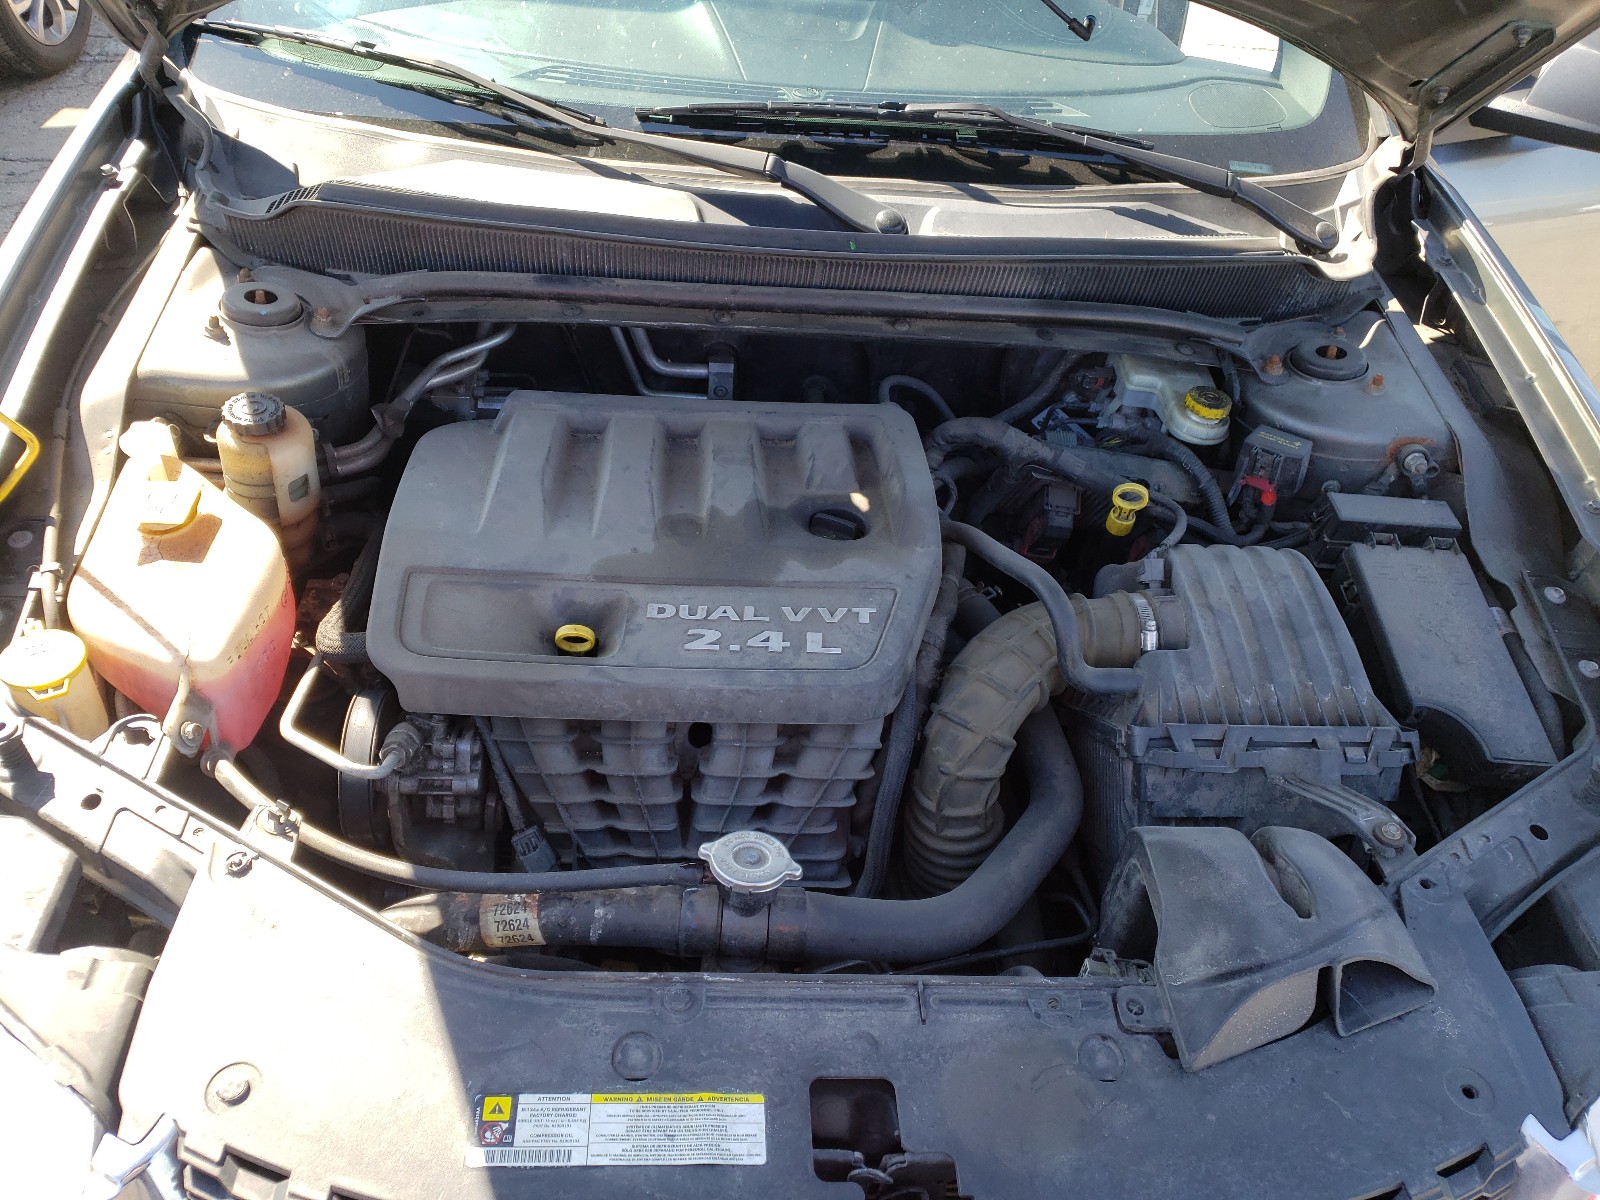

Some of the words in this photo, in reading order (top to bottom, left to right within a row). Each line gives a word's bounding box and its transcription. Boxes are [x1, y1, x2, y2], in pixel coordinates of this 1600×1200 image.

[646, 603, 770, 622] DUAL
[781, 606, 877, 624] VVT
[684, 628, 791, 653] 2.4
[806, 631, 842, 654] L
[493, 901, 528, 916] 72624
[493, 918, 530, 932] 72624
[496, 933, 534, 944] 72624
